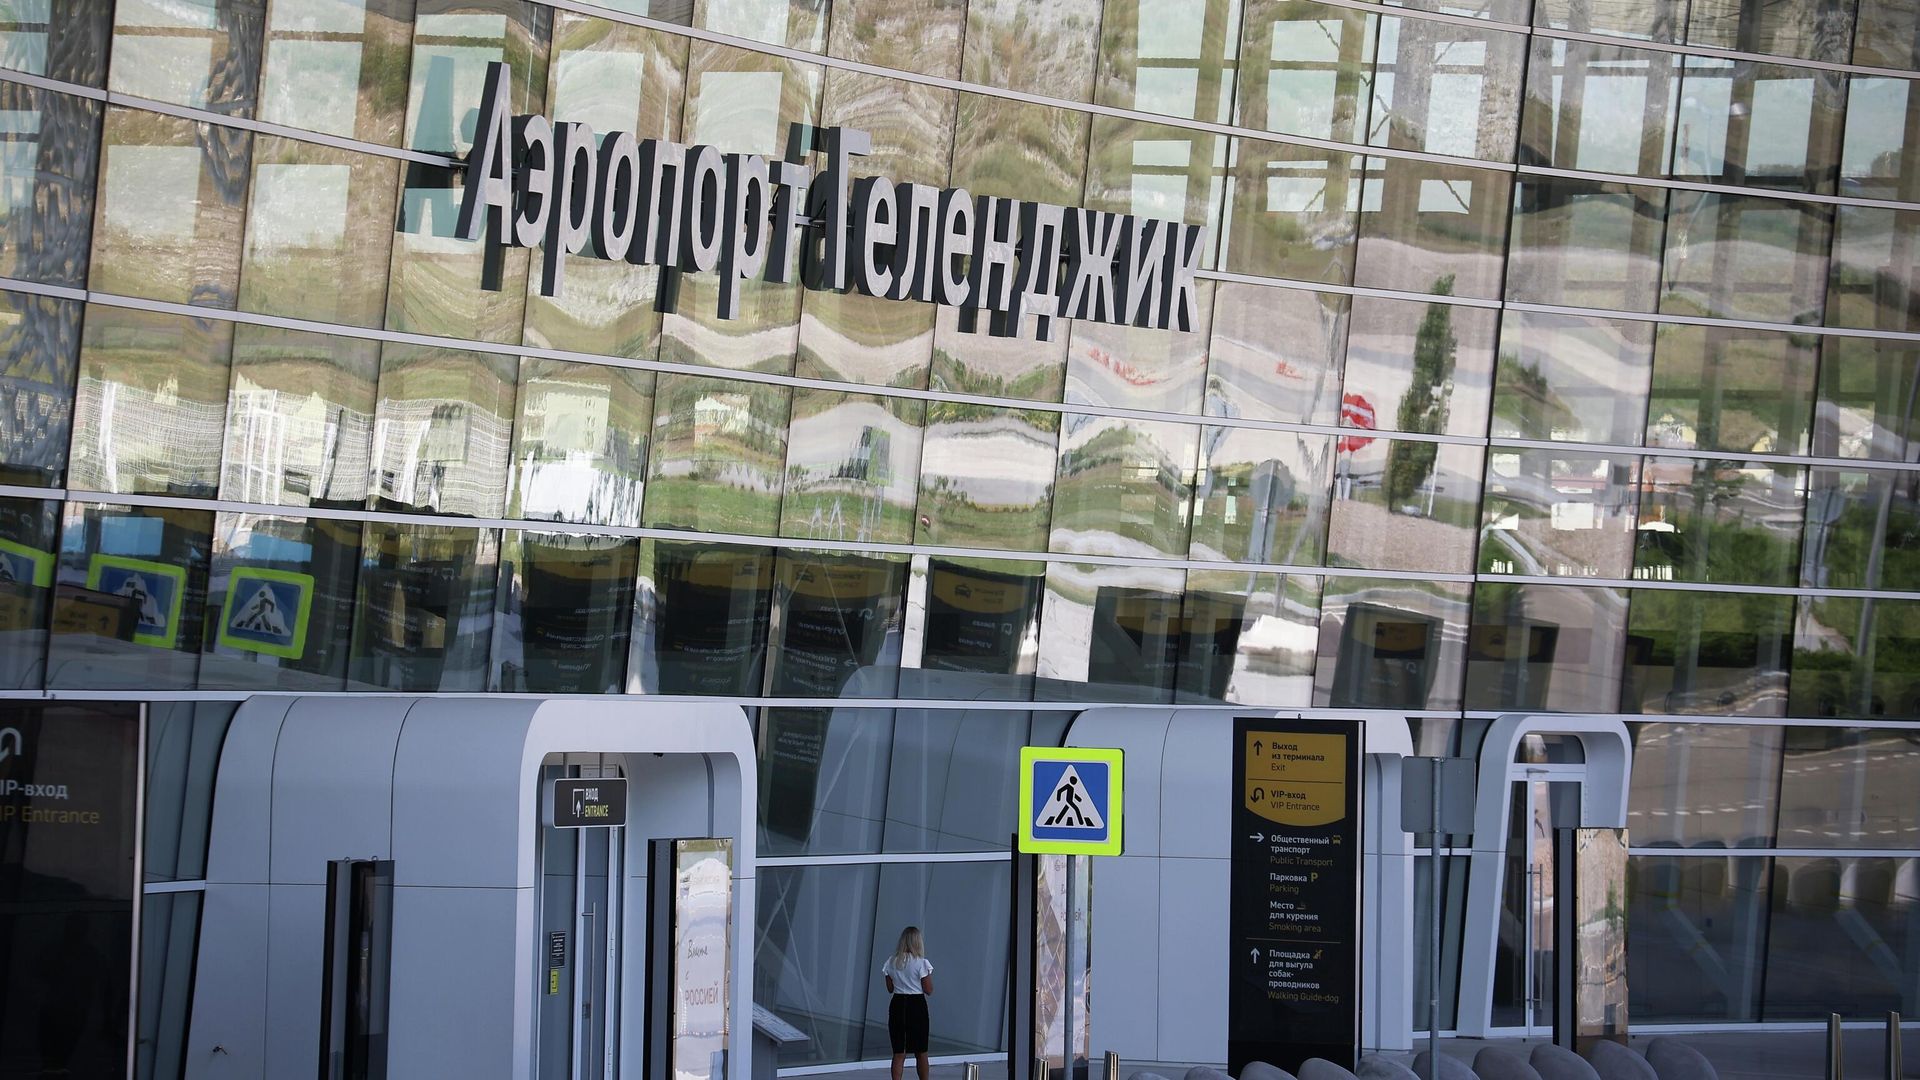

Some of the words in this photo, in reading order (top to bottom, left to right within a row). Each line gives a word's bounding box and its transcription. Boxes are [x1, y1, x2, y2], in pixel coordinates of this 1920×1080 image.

[455, 60, 811, 320] Аэропорт
[828, 126, 1208, 342] Геленджик
[1272, 741, 1298, 751] Выход
[1283, 753, 1325, 762] терминала
[1271, 763, 1286, 772] Exit
[0, 779, 69, 800] IP-вход
[1270, 789, 1306, 800] VIP-вход
[584, 804, 609, 818] ENTRANCE
[1270, 801, 1285, 809] VIP
[1286, 801, 1320, 811] Entrance
[22, 805, 100, 824] Entrance
[1270, 834, 1330, 845] Общественный
[1270, 845, 1311, 855] транспорт
[1270, 855, 1294, 865] Public
[1296, 856, 1333, 867] Transport
[1269, 872, 1308, 883] Парковка
[1269, 884, 1299, 895] Parking
[1269, 900, 1295, 910] Место
[1269, 912, 1285, 920] для
[1286, 912, 1319, 922] курения
[1269, 922, 1302, 933] Smoking
[1303, 924, 1321, 933] area
[1269, 949, 1311, 960] Площадка
[1268, 961, 1284, 969] для
[1285, 961, 1313, 970] выгула
[1268, 969, 1294, 978] собак-
[1268, 981, 1320, 989] проводников
[684, 980, 719, 1006] РОССИЕЙ
[1267, 990, 1299, 1002] Walking
[1300, 991, 1339, 1004] Guide-dog
